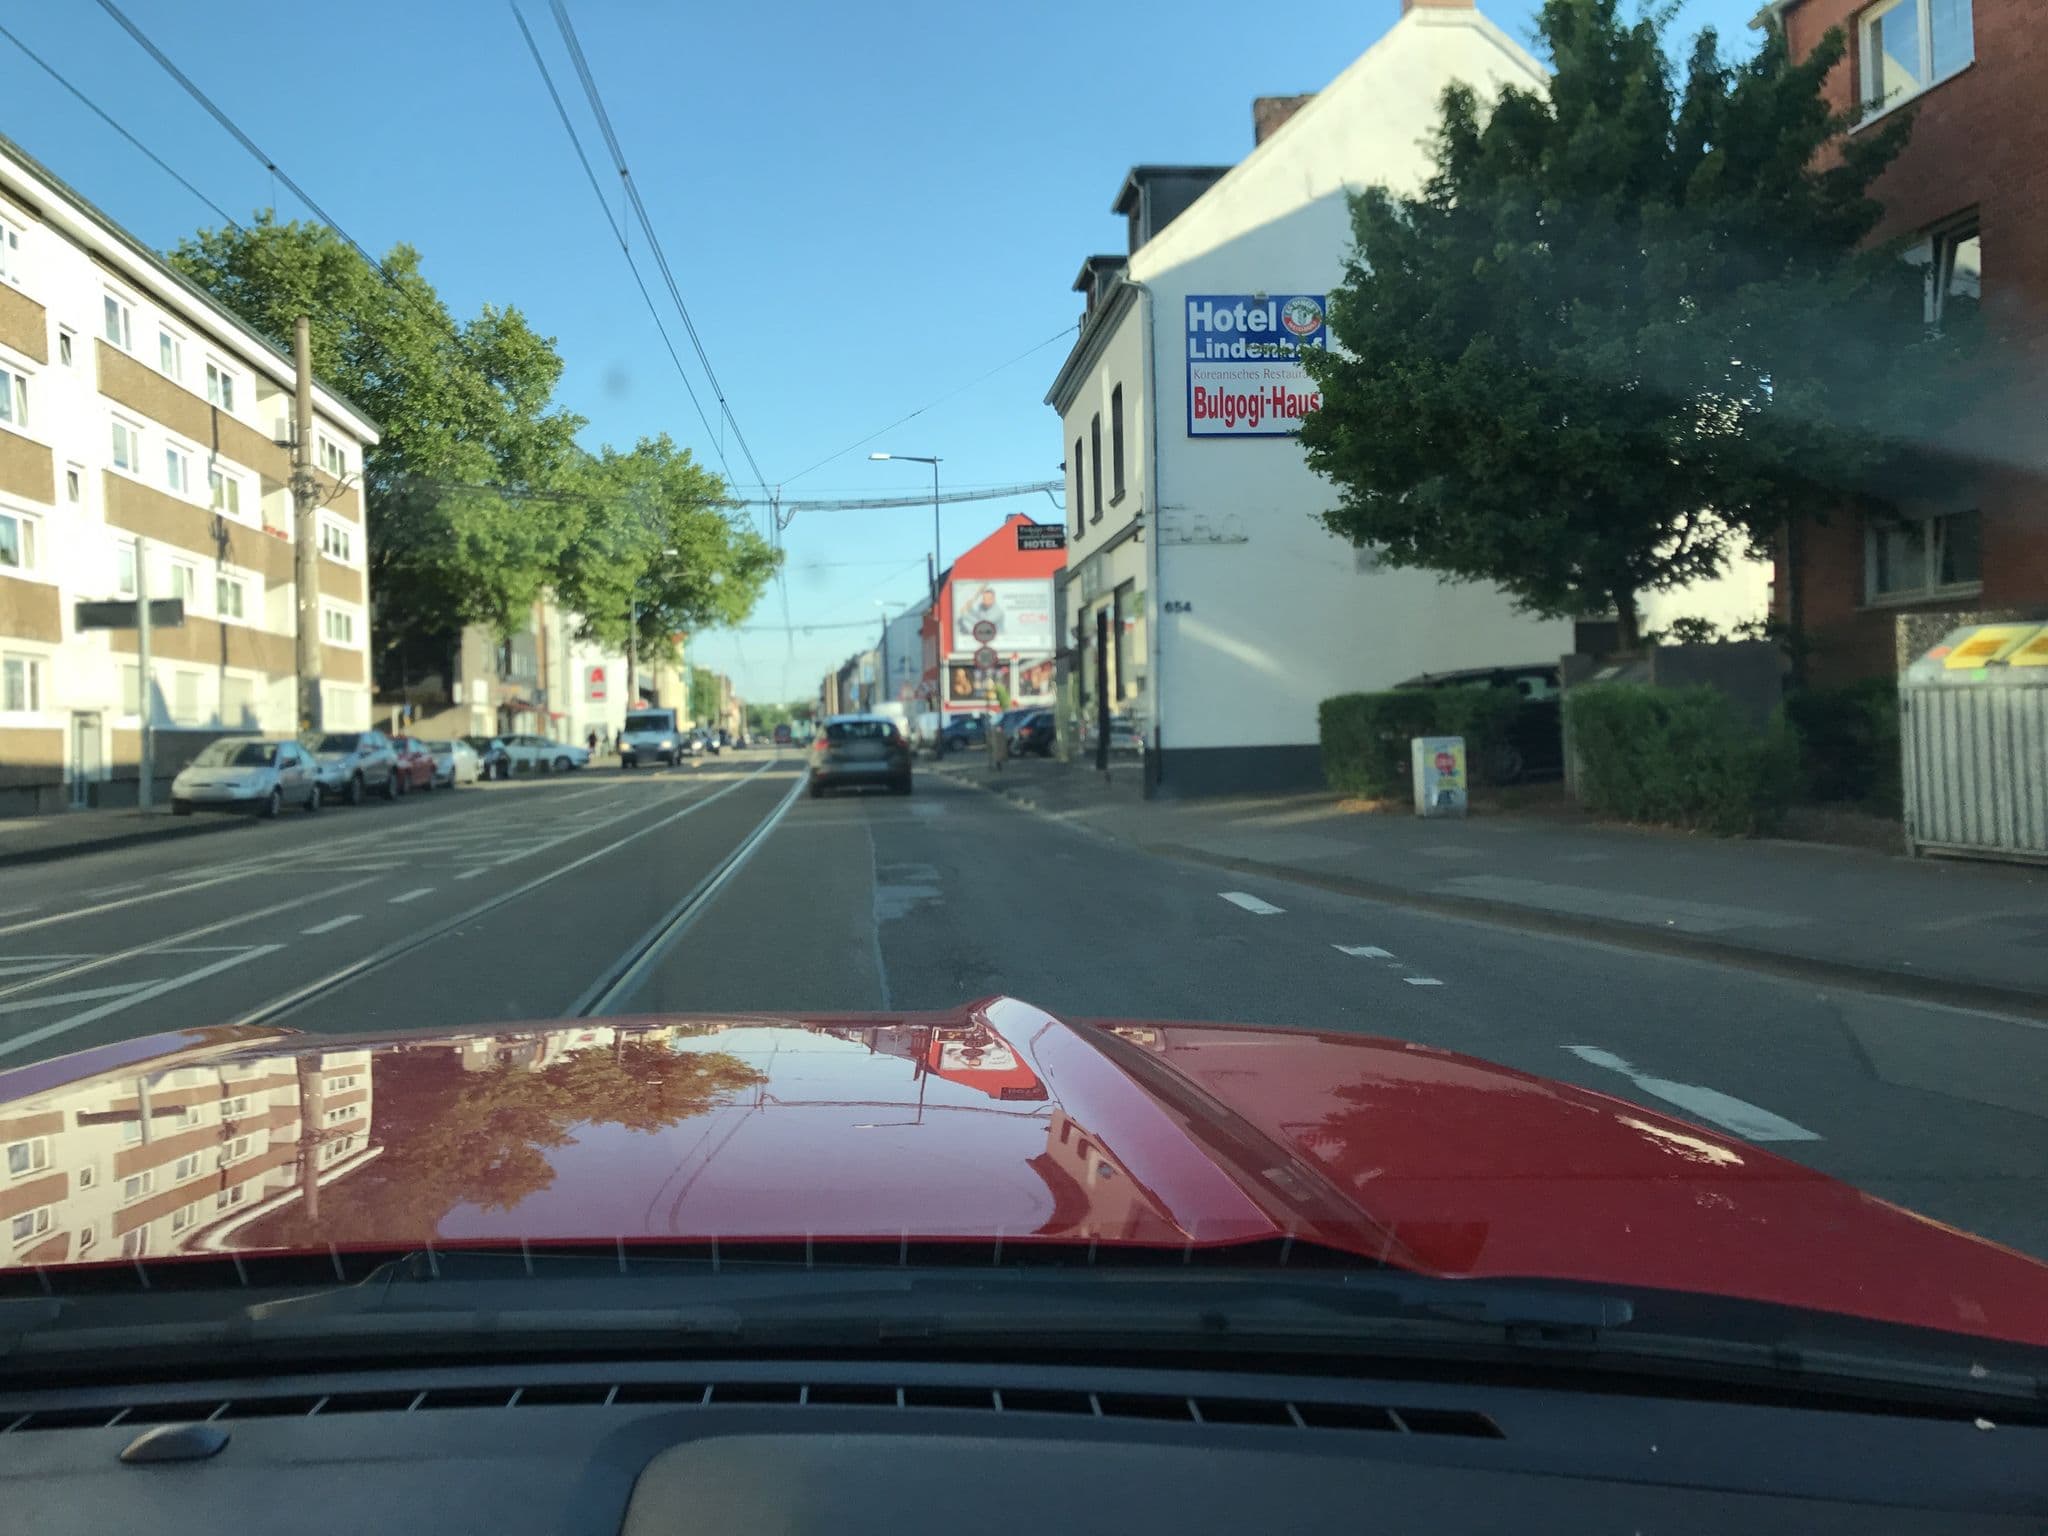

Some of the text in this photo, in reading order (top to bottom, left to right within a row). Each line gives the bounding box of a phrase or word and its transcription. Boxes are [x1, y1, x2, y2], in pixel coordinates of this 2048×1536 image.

[1188, 301, 1277, 333] Hotel
[1193, 368, 1307, 380] Koreanisches Restaura
[1194, 385, 1321, 428] Bulgogi-Haus
[1023, 540, 1058, 549] HOTEL
[1164, 601, 1191, 613] 654
